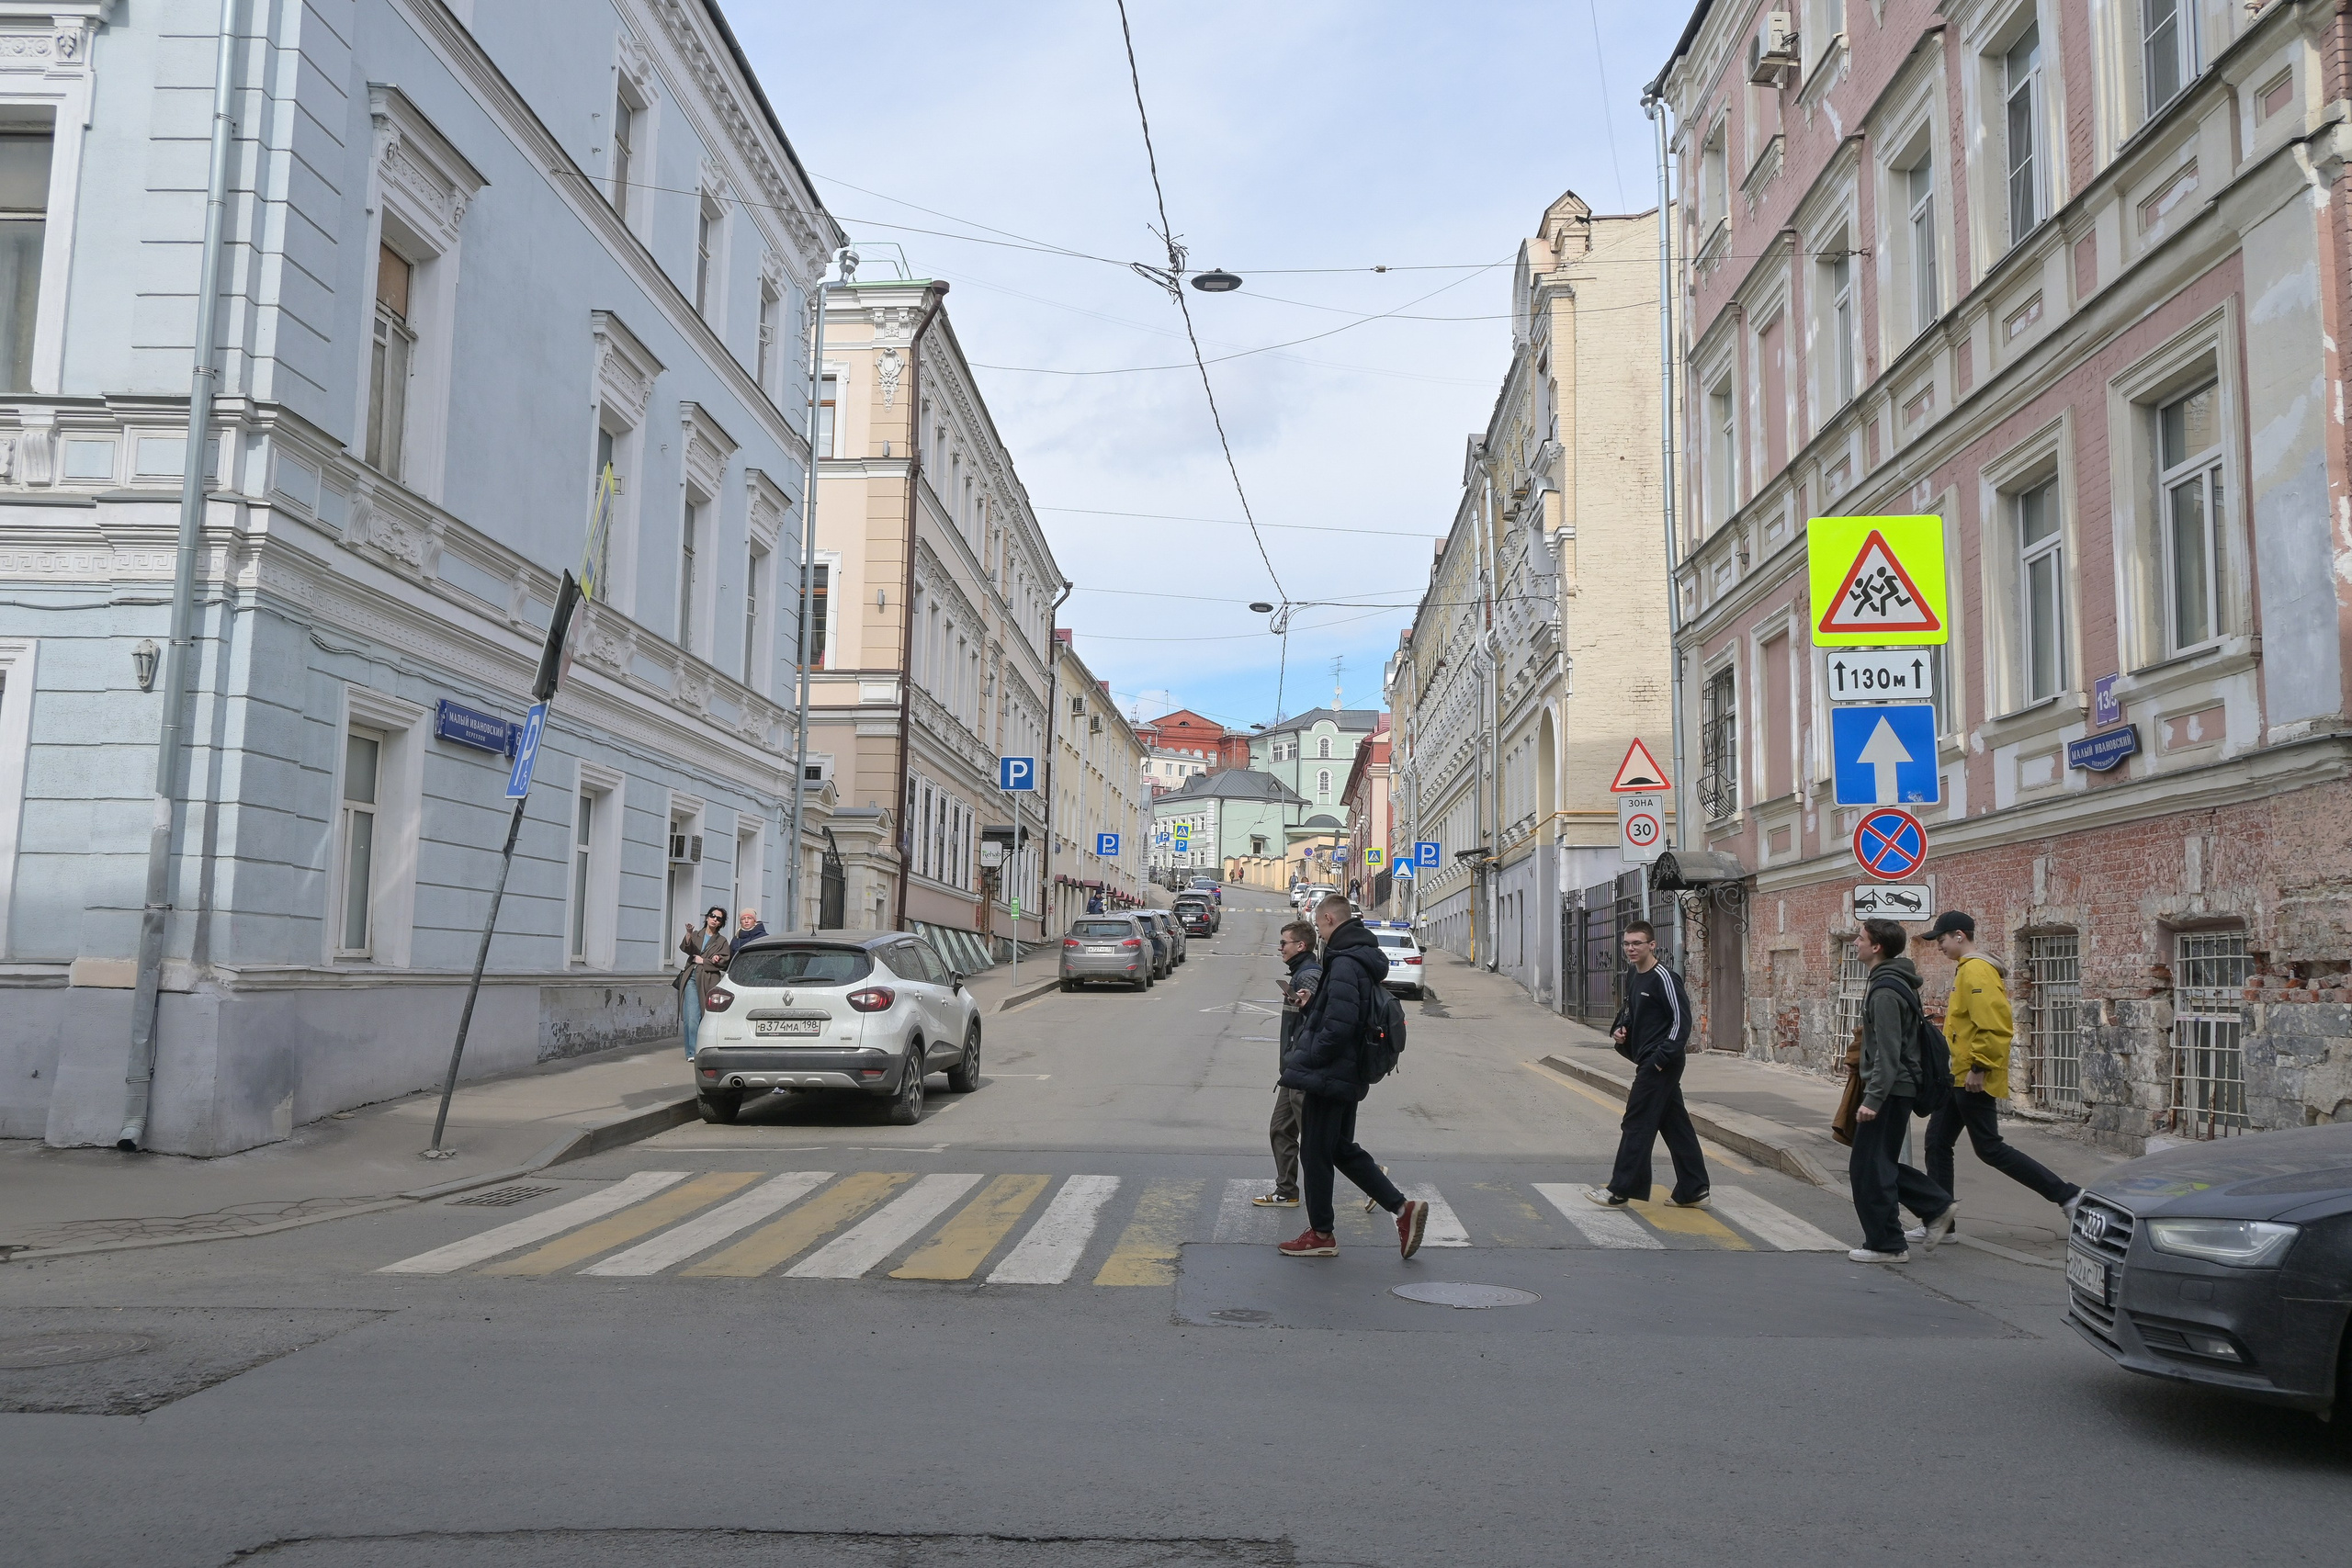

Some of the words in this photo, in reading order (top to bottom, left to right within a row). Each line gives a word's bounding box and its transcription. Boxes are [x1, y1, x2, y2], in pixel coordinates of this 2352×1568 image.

[449, 712, 469, 728] МАЛЫЙ
[469, 718, 503, 739] ИВАНОВСКИЙ
[466, 730, 485, 742] ПЕРЕУЛОК
[2072, 744, 2093, 761] МАЛЫЙ
[2095, 734, 2132, 754] ИВАНОВСКИЙ
[2092, 756, 2114, 766] ПЕРЕУЛОК
[1009, 761, 1028, 787] P
[1628, 798, 1654, 807] ЗОНА
[1634, 823, 1651, 837] 30
